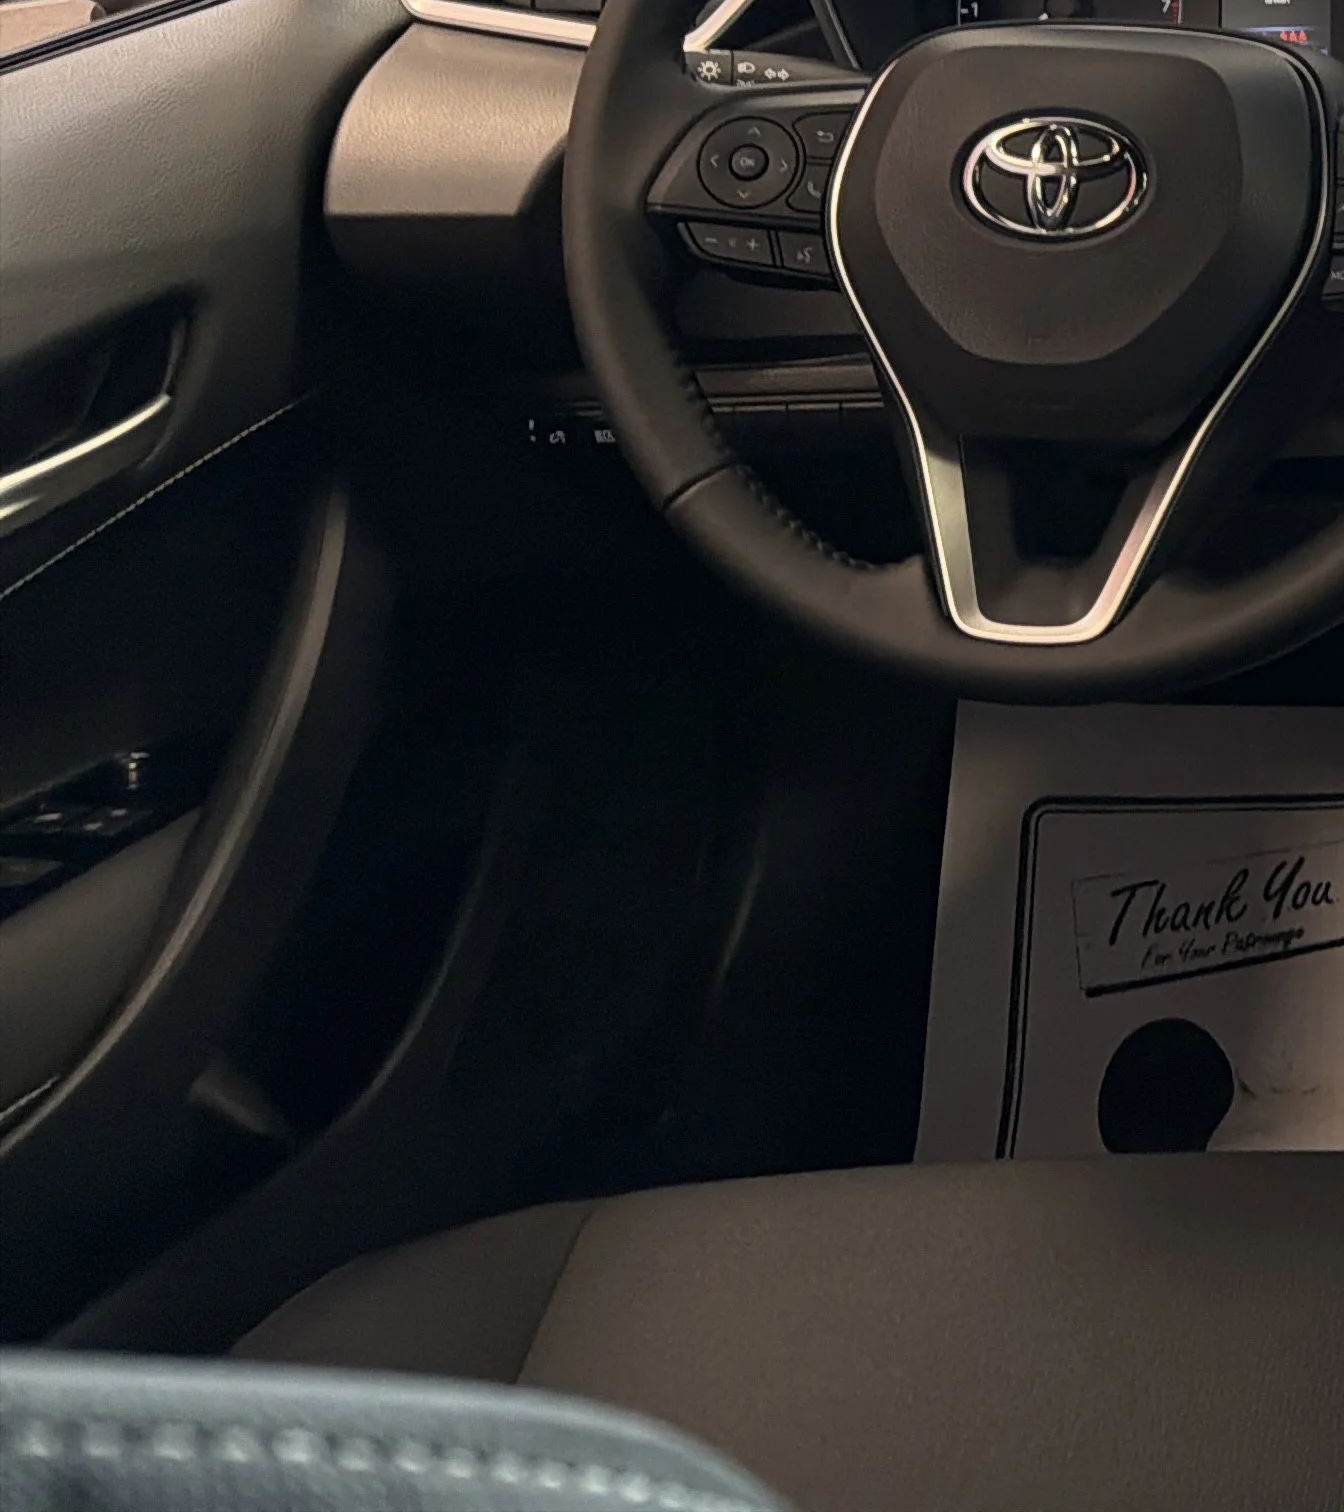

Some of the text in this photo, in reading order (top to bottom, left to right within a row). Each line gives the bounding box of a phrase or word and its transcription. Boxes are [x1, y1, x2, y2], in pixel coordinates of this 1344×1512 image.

[1108, 856, 1335, 946] Thank You
[1140, 941, 1172, 970] For
[1178, 938, 1217, 964] Your
